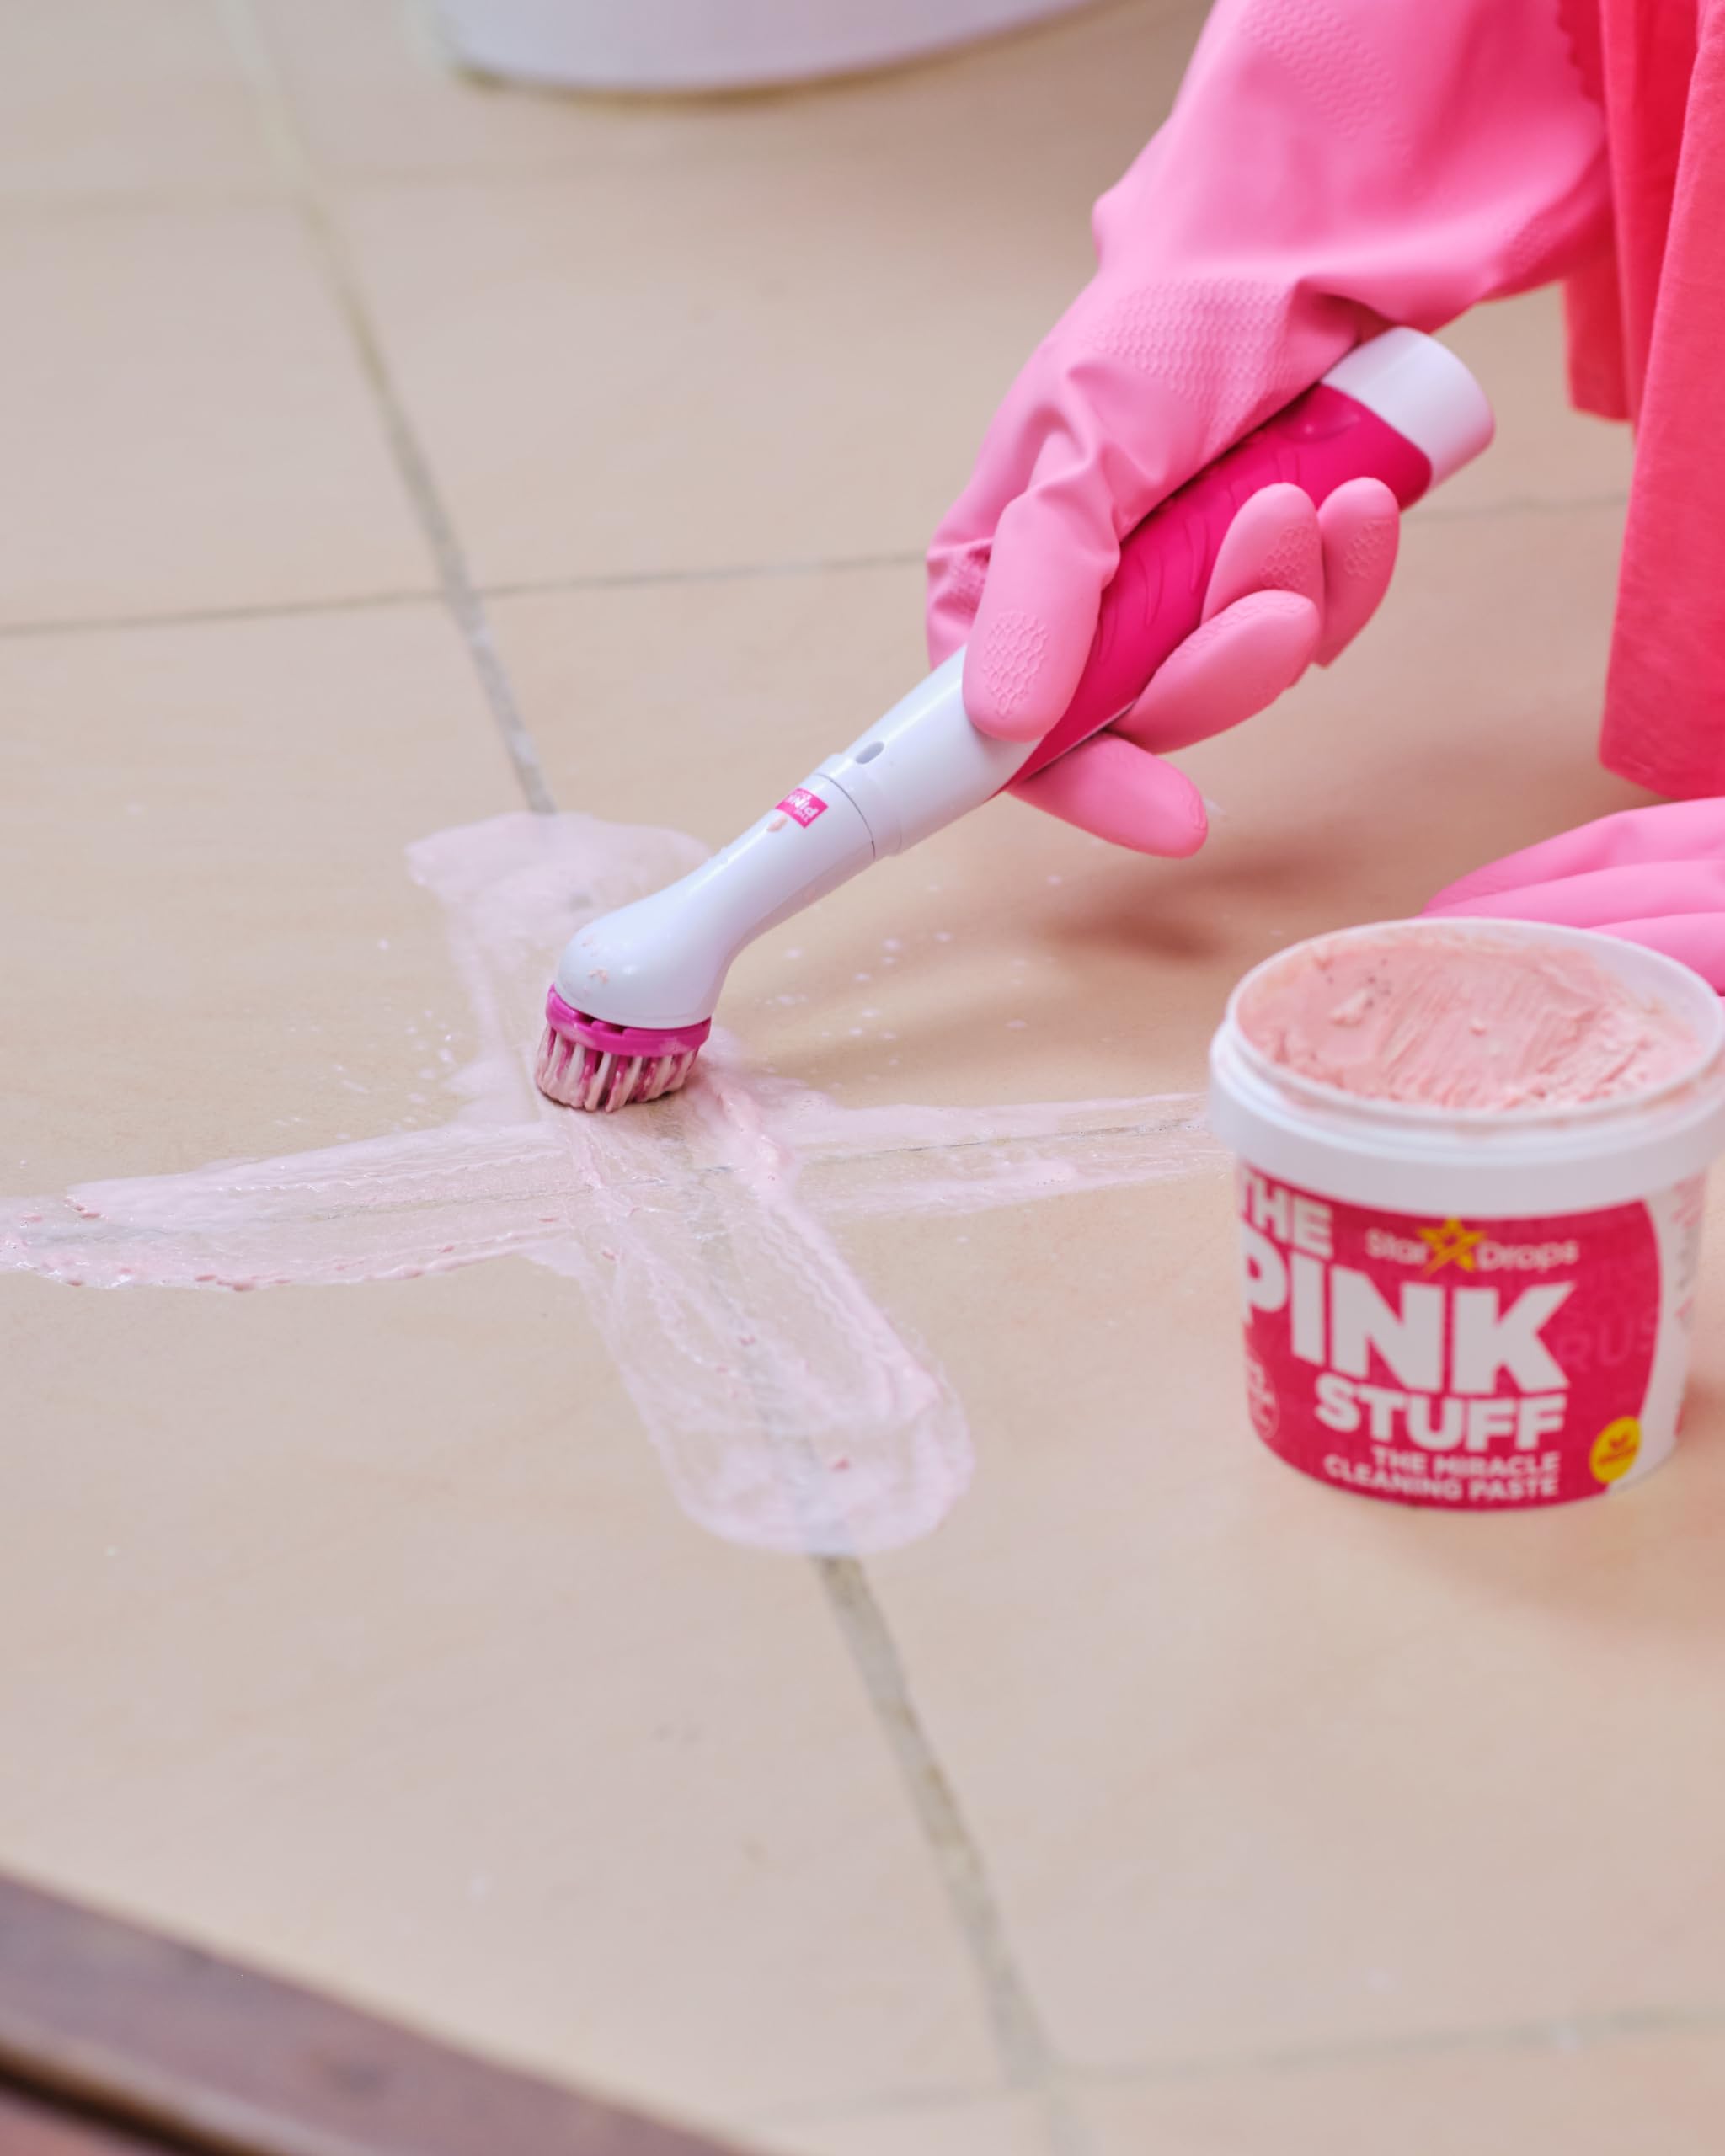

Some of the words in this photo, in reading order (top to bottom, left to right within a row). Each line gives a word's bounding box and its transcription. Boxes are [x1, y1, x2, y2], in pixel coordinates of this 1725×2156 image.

[1242, 1165, 1333, 1260] THE
[1365, 1227, 1428, 1264] Star
[1477, 1241, 1579, 1274] Drops
[1242, 1221, 1575, 1395] PINK
[1315, 1374, 1567, 1451] STUFF
[1323, 1454, 1462, 1501] CLEANING
[1468, 1474, 1559, 1501] PASTE
[1371, 1444, 1428, 1474] THE
[1434, 1450, 1561, 1477] MIRACLE
